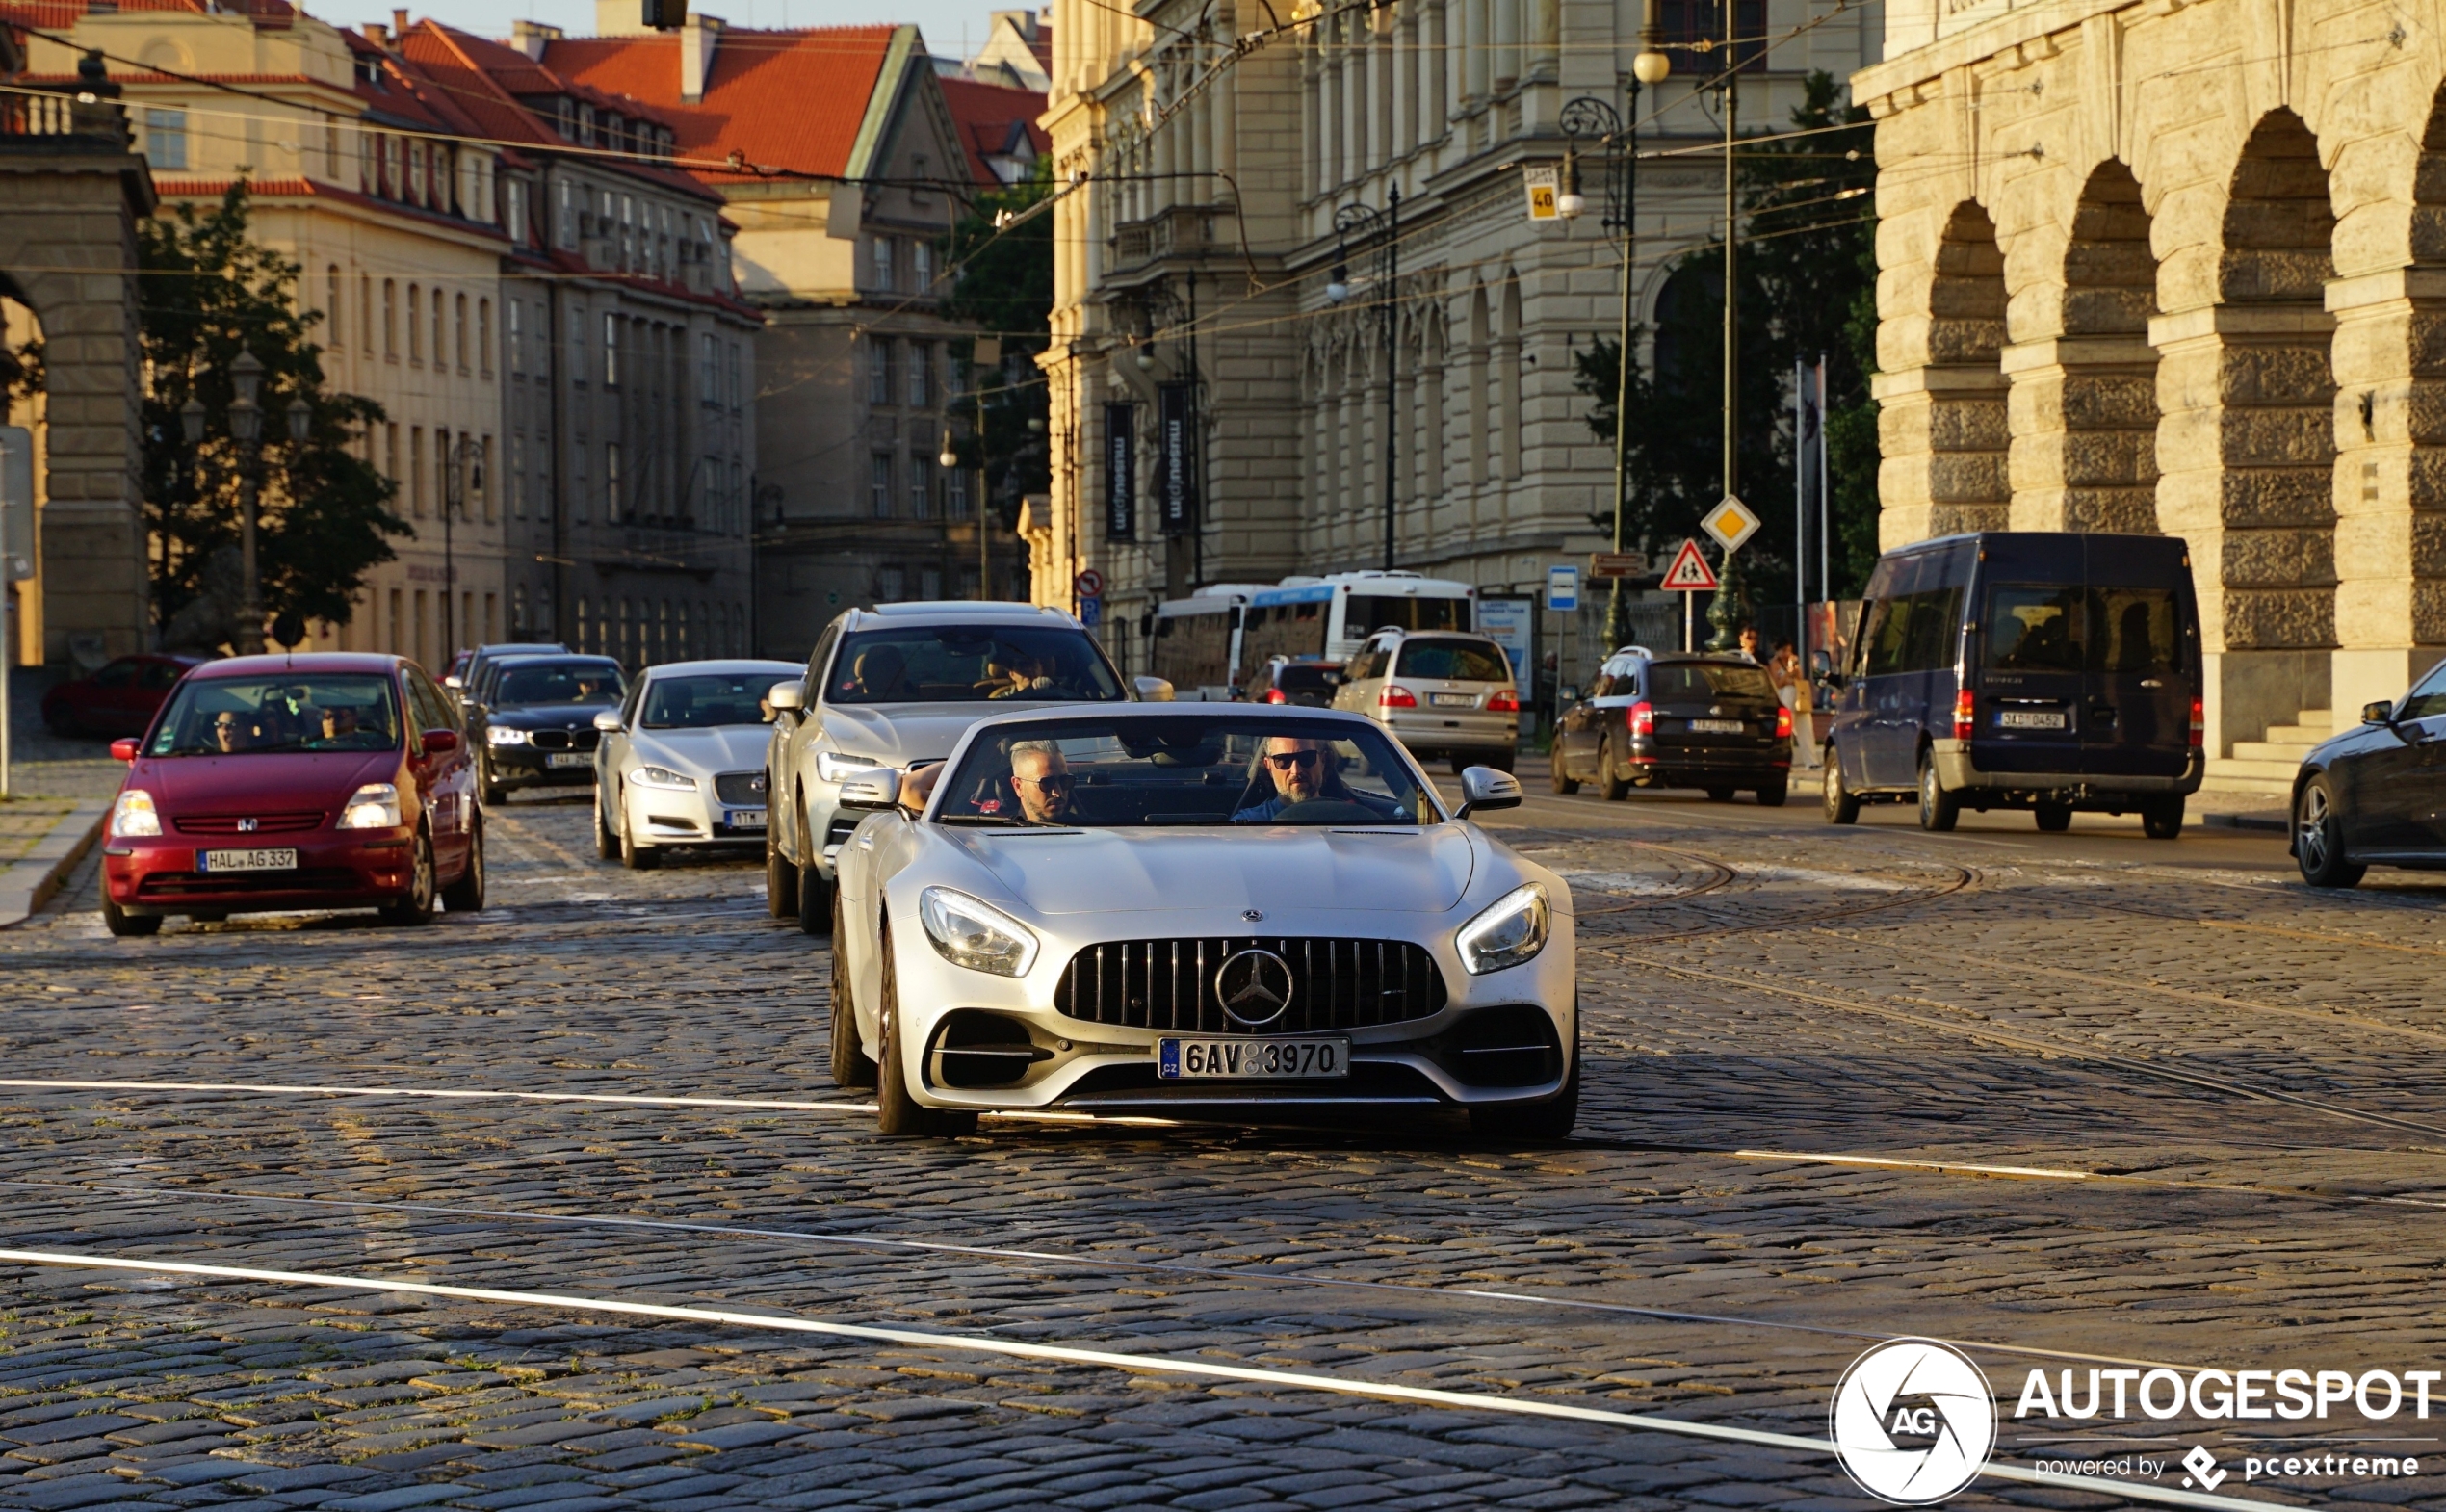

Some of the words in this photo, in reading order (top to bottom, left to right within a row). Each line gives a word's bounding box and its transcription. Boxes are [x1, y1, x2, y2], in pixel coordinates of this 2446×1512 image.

[1533, 193, 1553, 208] 40
[2032, 715, 2059, 726] 0452
[209, 853, 236, 869] HAL
[247, 852, 266, 867] AG
[269, 850, 294, 866] 337
[1163, 1063, 1177, 1073] CZ
[1185, 1044, 1239, 1074] 6AV
[1262, 1043, 1335, 1074] 3970
